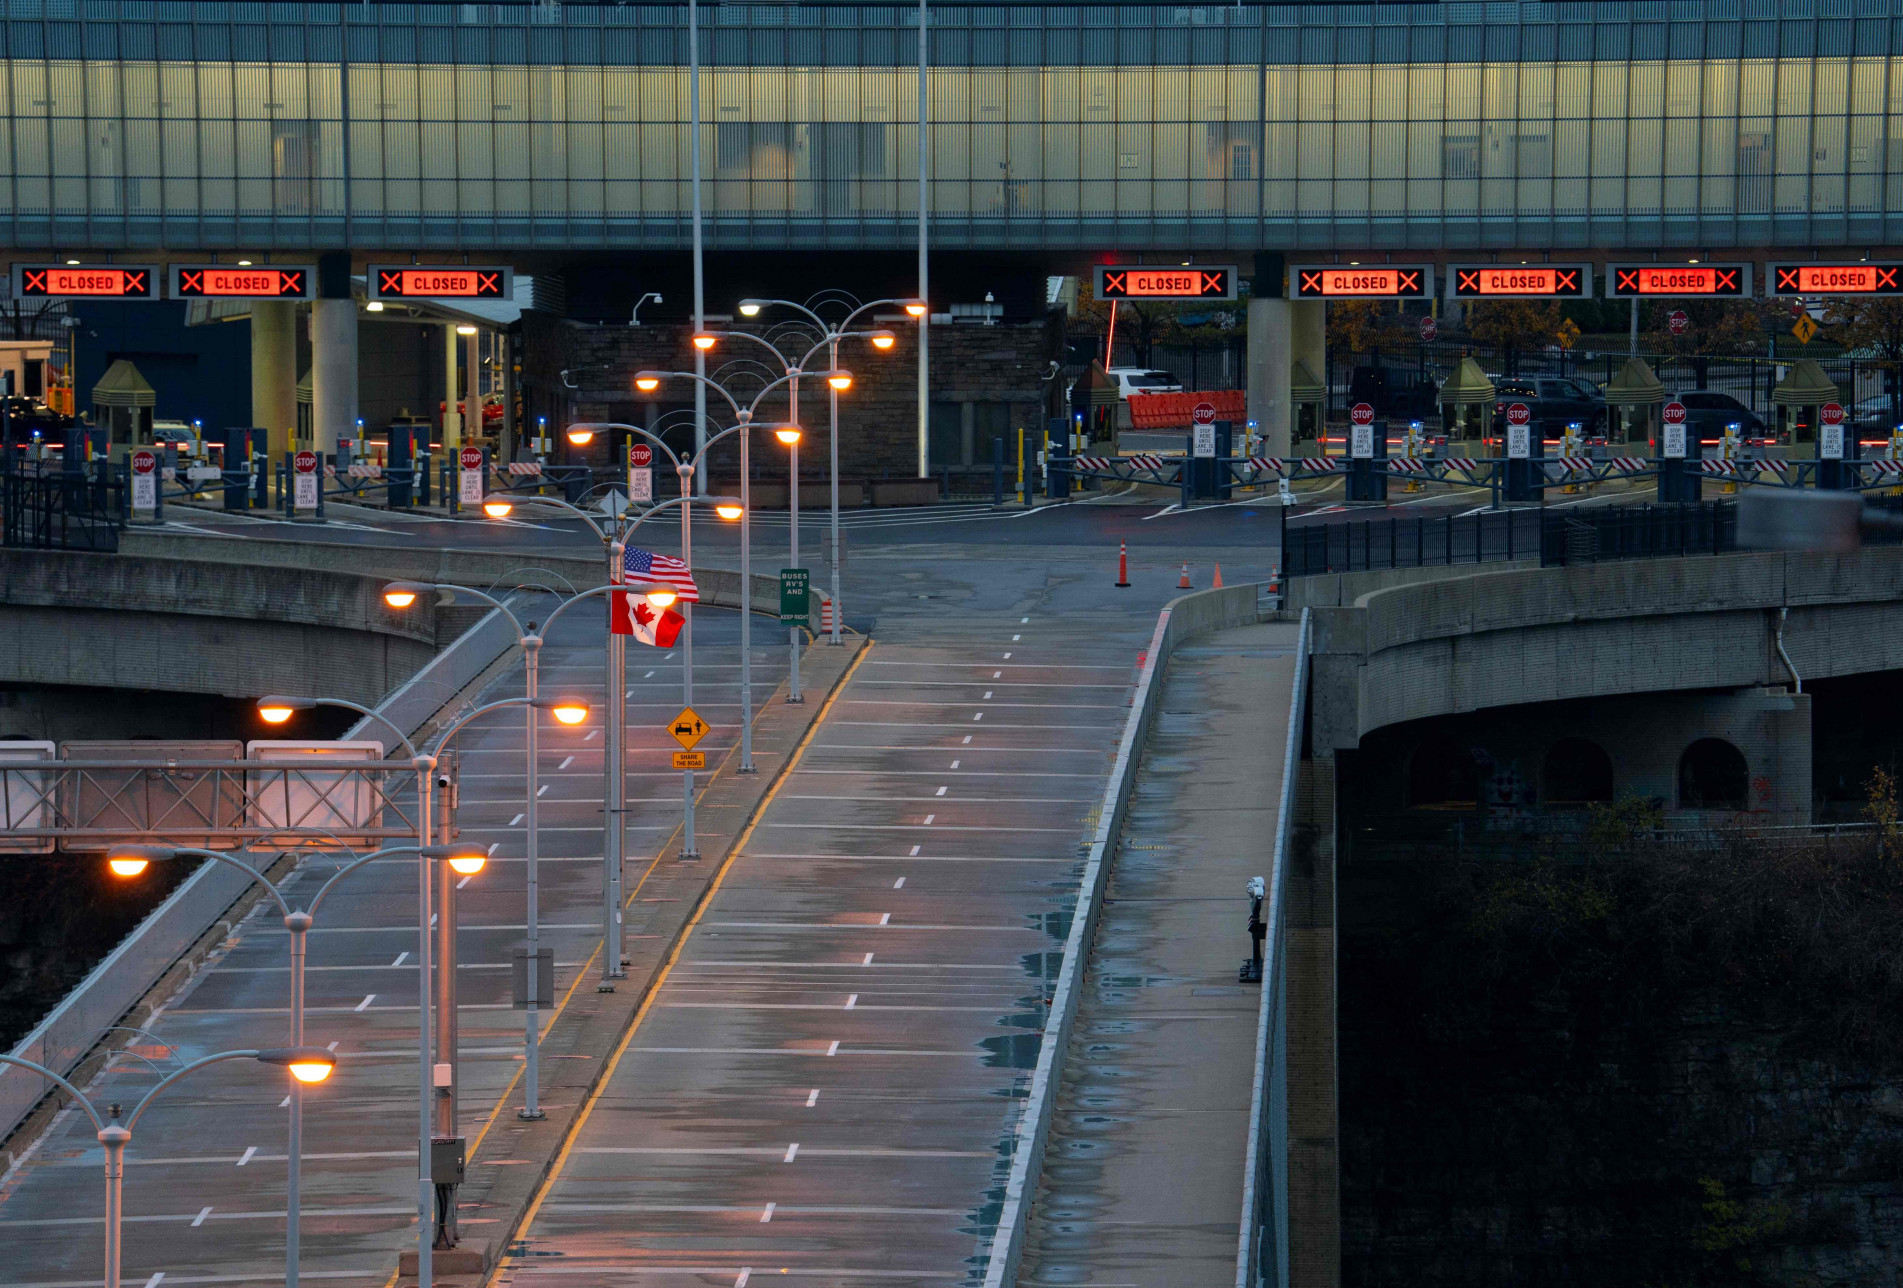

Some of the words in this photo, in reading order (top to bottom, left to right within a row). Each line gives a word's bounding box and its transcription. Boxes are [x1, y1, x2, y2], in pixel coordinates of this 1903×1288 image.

[60, 277, 113, 289] CLOSED
[216, 277, 269, 289] CLOSED
[414, 277, 467, 289] CLOSED
[1138, 277, 1191, 290] CLOSED
[1334, 277, 1387, 289] CLOSED
[1492, 276, 1545, 288] CLOSED
[1650, 275, 1704, 287] CLOSED
[1811, 274, 1865, 286] CLOSED
[1195, 410, 1214, 418] STOP
[1353, 410, 1372, 419] STOP
[1509, 410, 1528, 419] STOP
[1665, 409, 1684, 418] STOP
[1823, 410, 1842, 418] STOP
[461, 454, 480, 462] STOP
[631, 451, 650, 460] STOP
[134, 458, 153, 467] STOP
[296, 458, 315, 466] STOP
